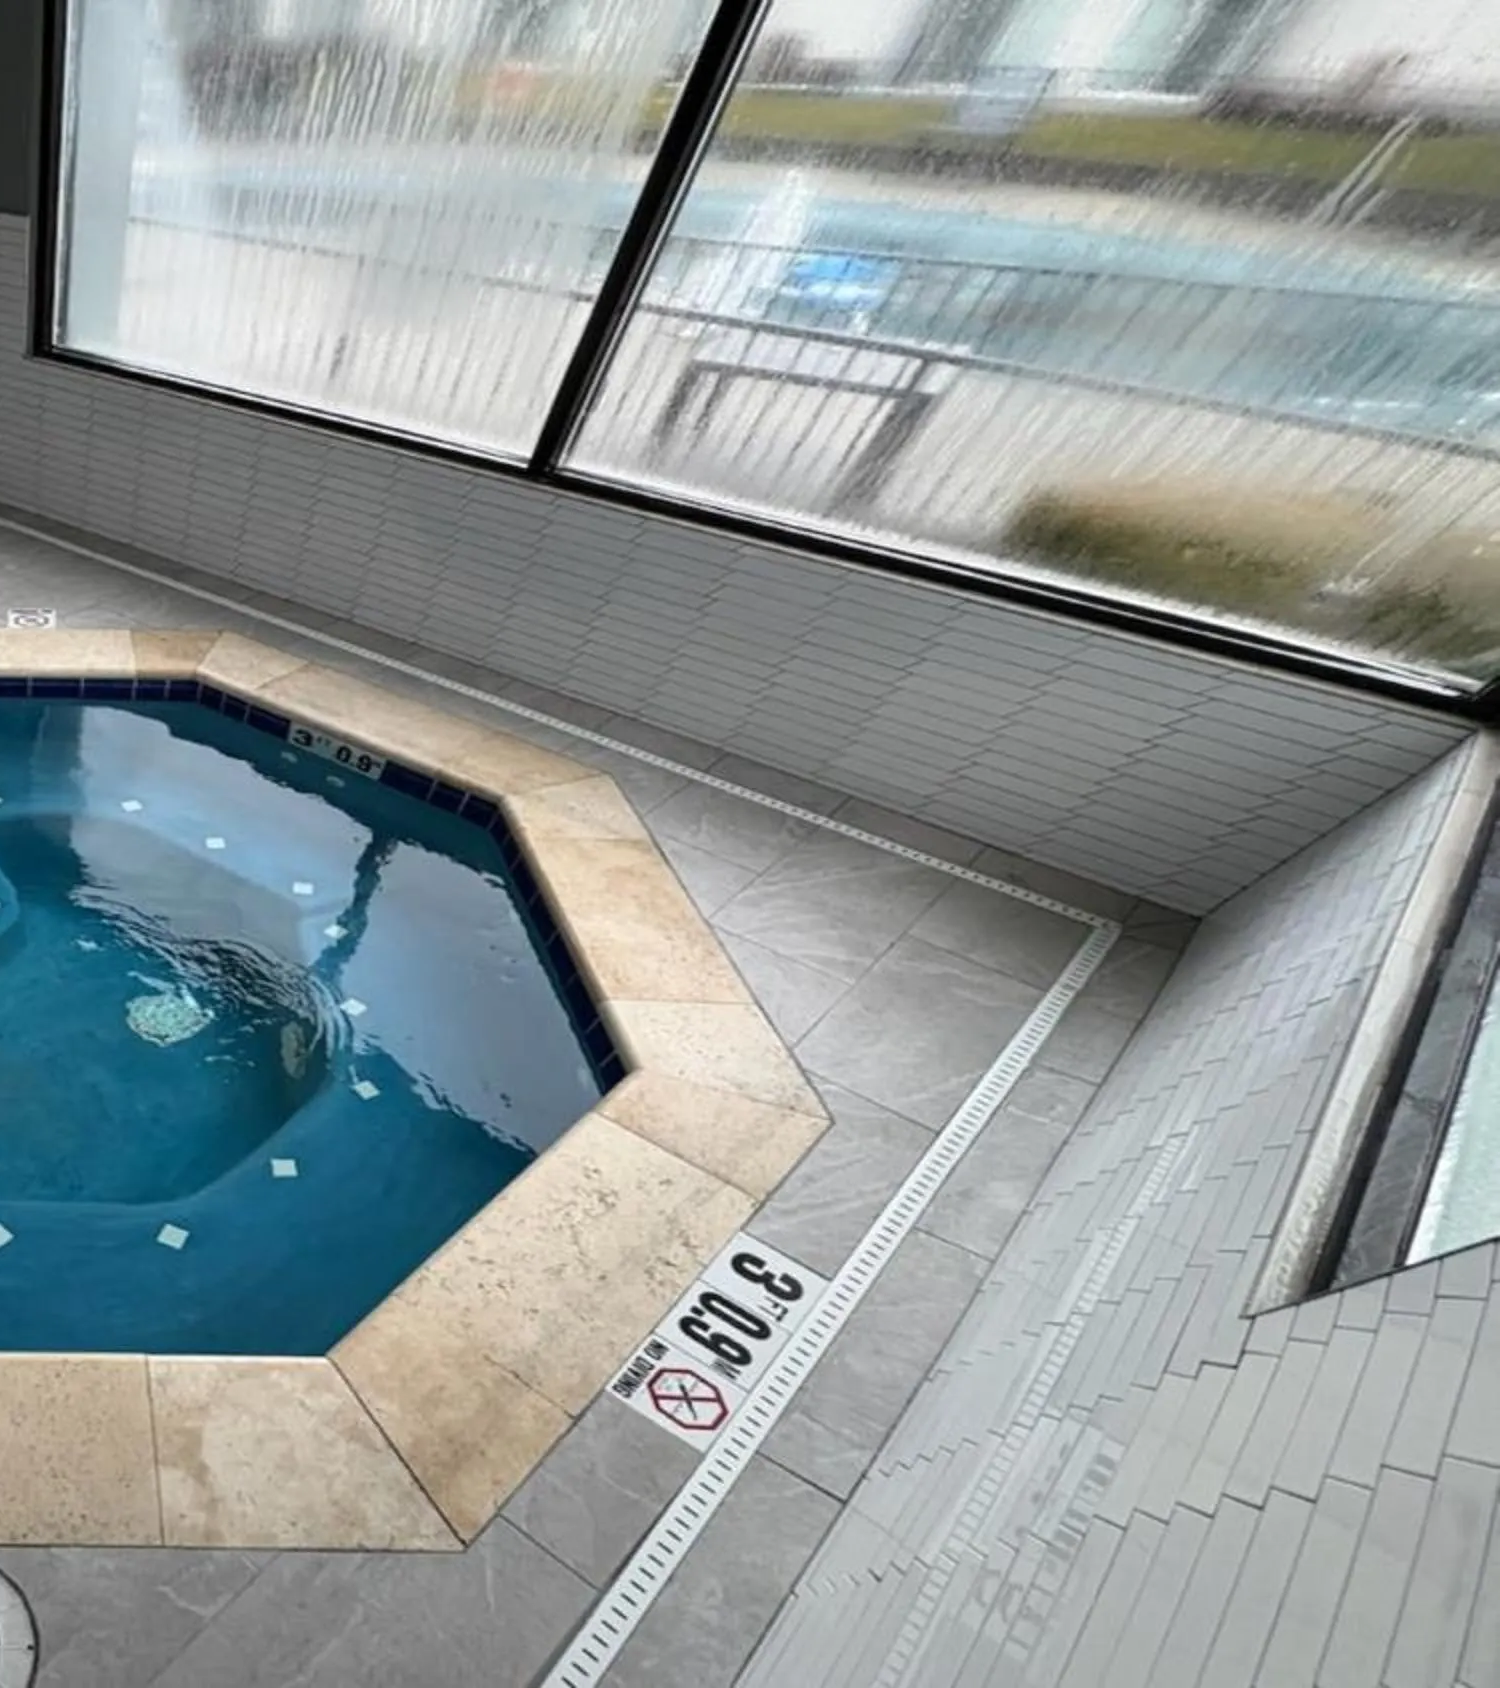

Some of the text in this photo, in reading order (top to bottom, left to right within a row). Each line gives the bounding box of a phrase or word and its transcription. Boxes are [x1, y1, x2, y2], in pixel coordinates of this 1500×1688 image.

[292, 728, 313, 747] 3
[731, 1252, 804, 1302] 3
[679, 1291, 771, 1366] 0.9
[758, 1295, 788, 1322] FT
[612, 1339, 669, 1398] NO DIVING
